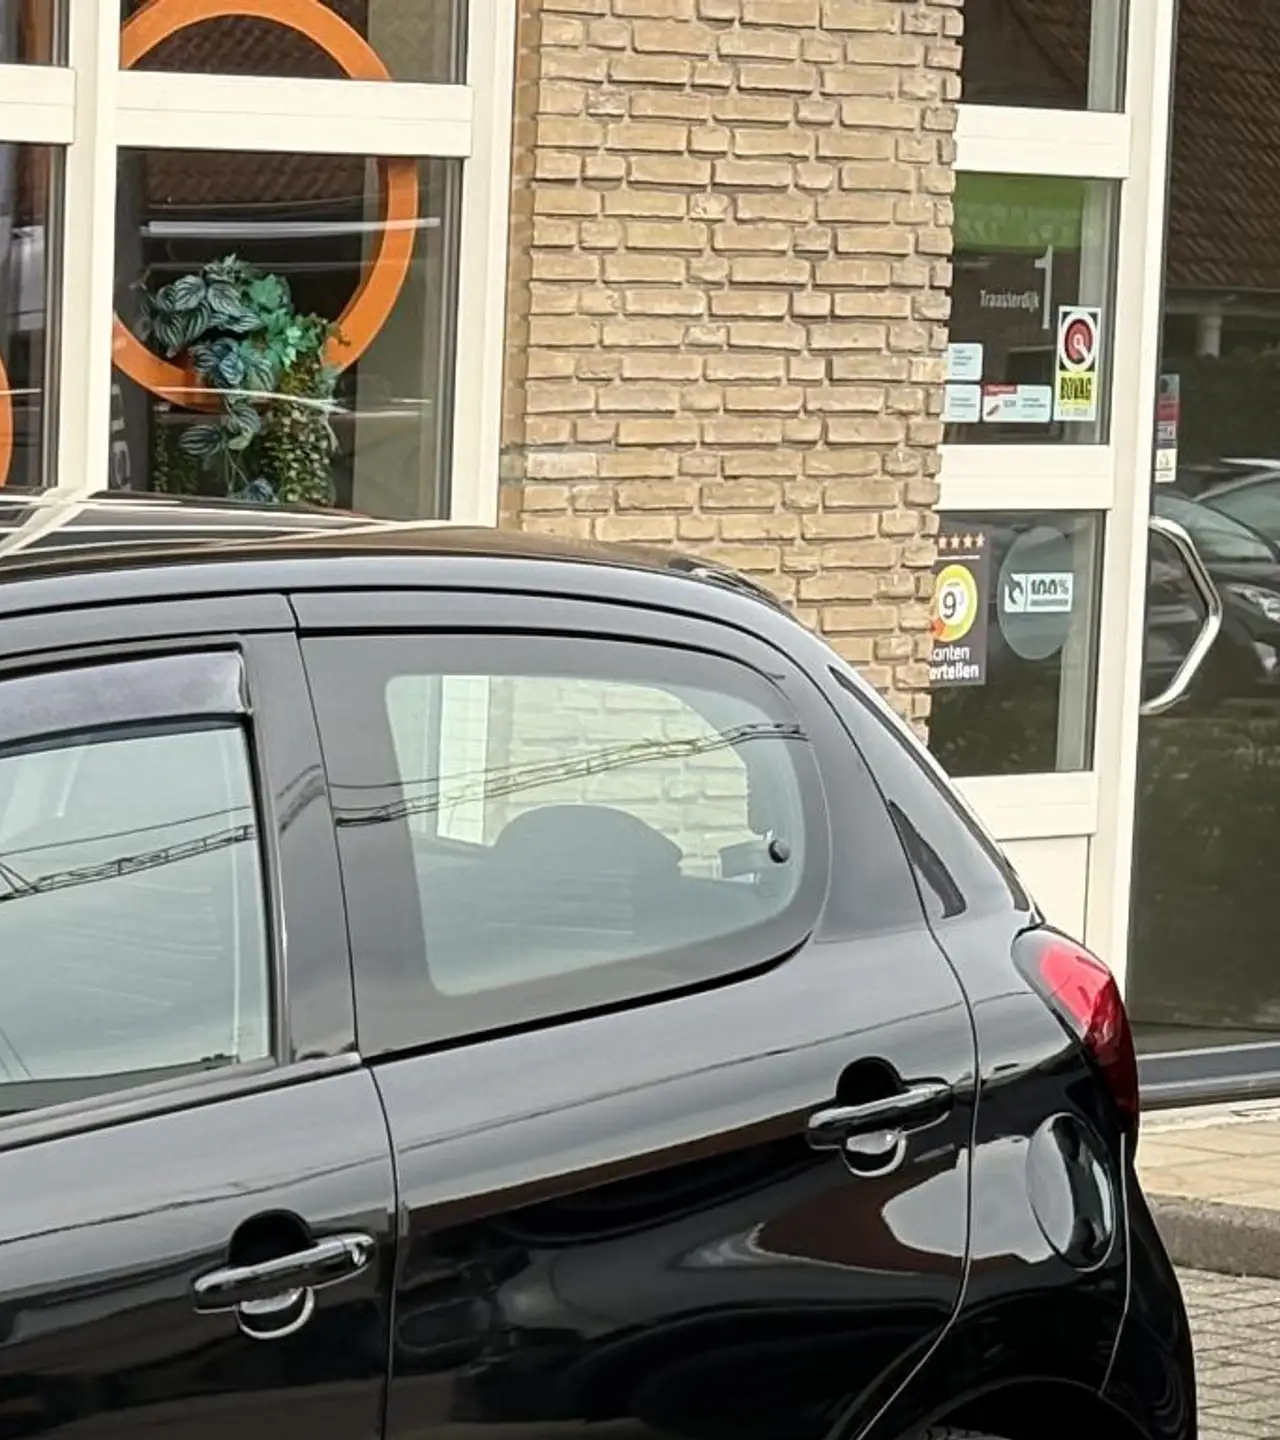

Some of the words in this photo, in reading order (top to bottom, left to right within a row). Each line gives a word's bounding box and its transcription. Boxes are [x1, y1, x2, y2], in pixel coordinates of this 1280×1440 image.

[1034, 244, 1054, 330] 1
[980, 289, 1040, 313] Traasterdijk
[1059, 377, 1092, 401] BOVAG
[1031, 579, 1069, 596] 100%
[933, 645, 971, 661] anten
[929, 662, 980, 681] ertellen
